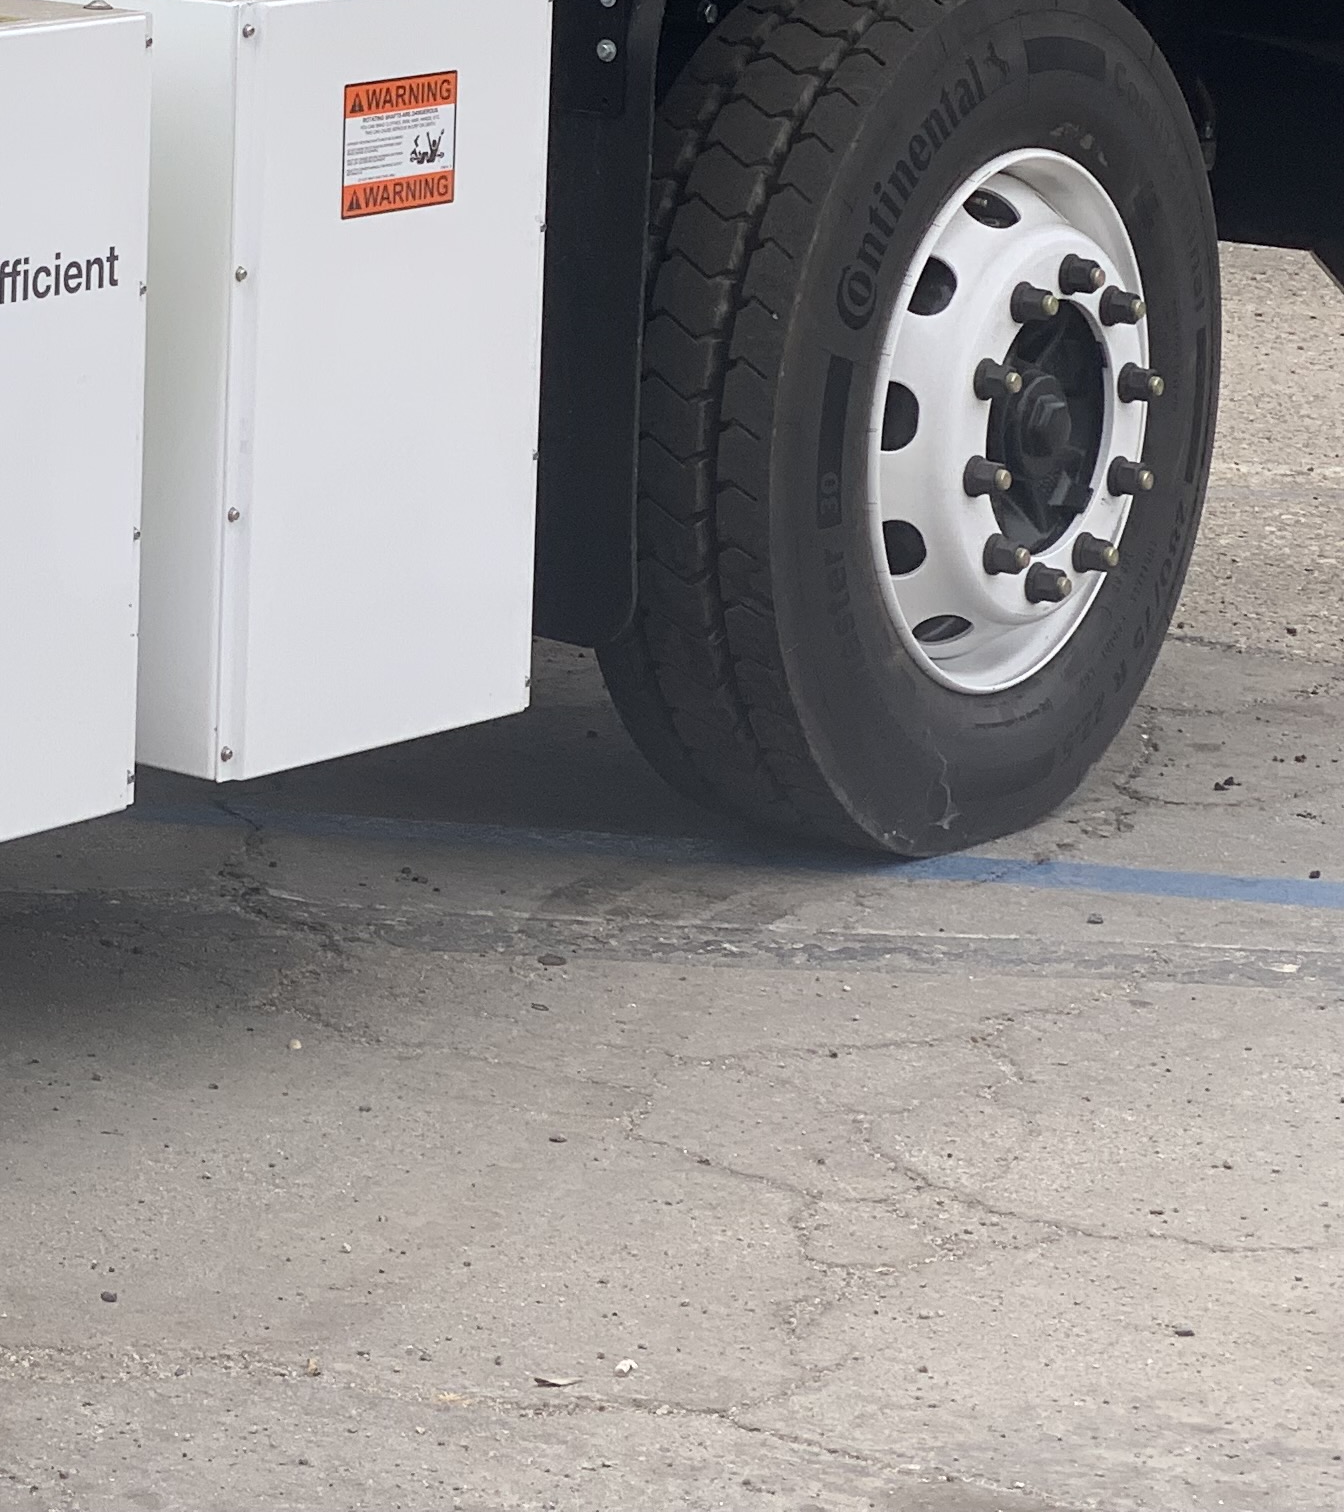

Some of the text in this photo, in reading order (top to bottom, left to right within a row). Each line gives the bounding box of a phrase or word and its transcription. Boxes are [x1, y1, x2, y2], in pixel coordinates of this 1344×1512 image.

[365, 78, 452, 111] WARNING
[363, 175, 449, 209] WARNING
[835, 55, 987, 332] Continental
